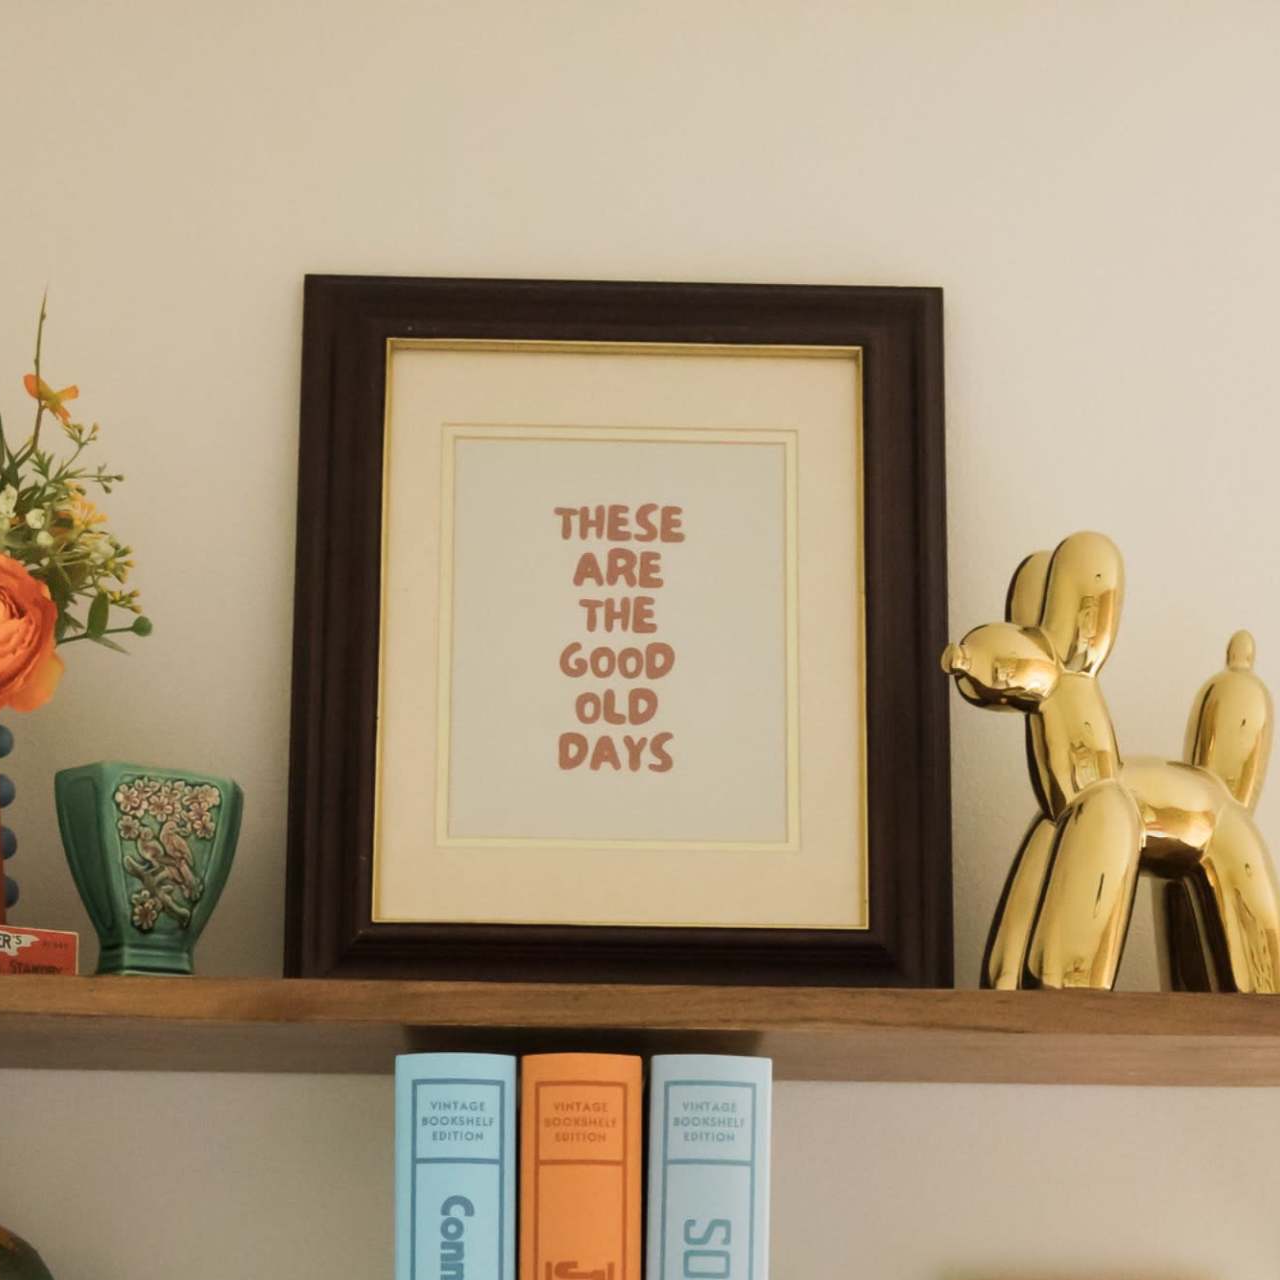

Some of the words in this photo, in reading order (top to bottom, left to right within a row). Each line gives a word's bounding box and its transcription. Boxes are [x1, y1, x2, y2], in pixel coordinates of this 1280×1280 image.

[554, 503, 686, 543] THESE
[573, 548, 664, 588] ARE
[579, 596, 658, 634] THE
[559, 642, 676, 680] GOOD
[575, 687, 659, 726] OLD
[558, 732, 675, 773] DAYS
[430, 1101, 486, 1112] VINTAGE
[553, 1101, 608, 1113] VINTAGE
[682, 1101, 737, 1113] VINTAGE
[421, 1116, 495, 1127] BOOKSHELF
[543, 1117, 617, 1128] BOOKSHELF
[672, 1116, 745, 1128] BOOKSHELF
[431, 1131, 484, 1142] EDITION
[554, 1132, 607, 1143] EDITION
[683, 1131, 735, 1142] EDITION
